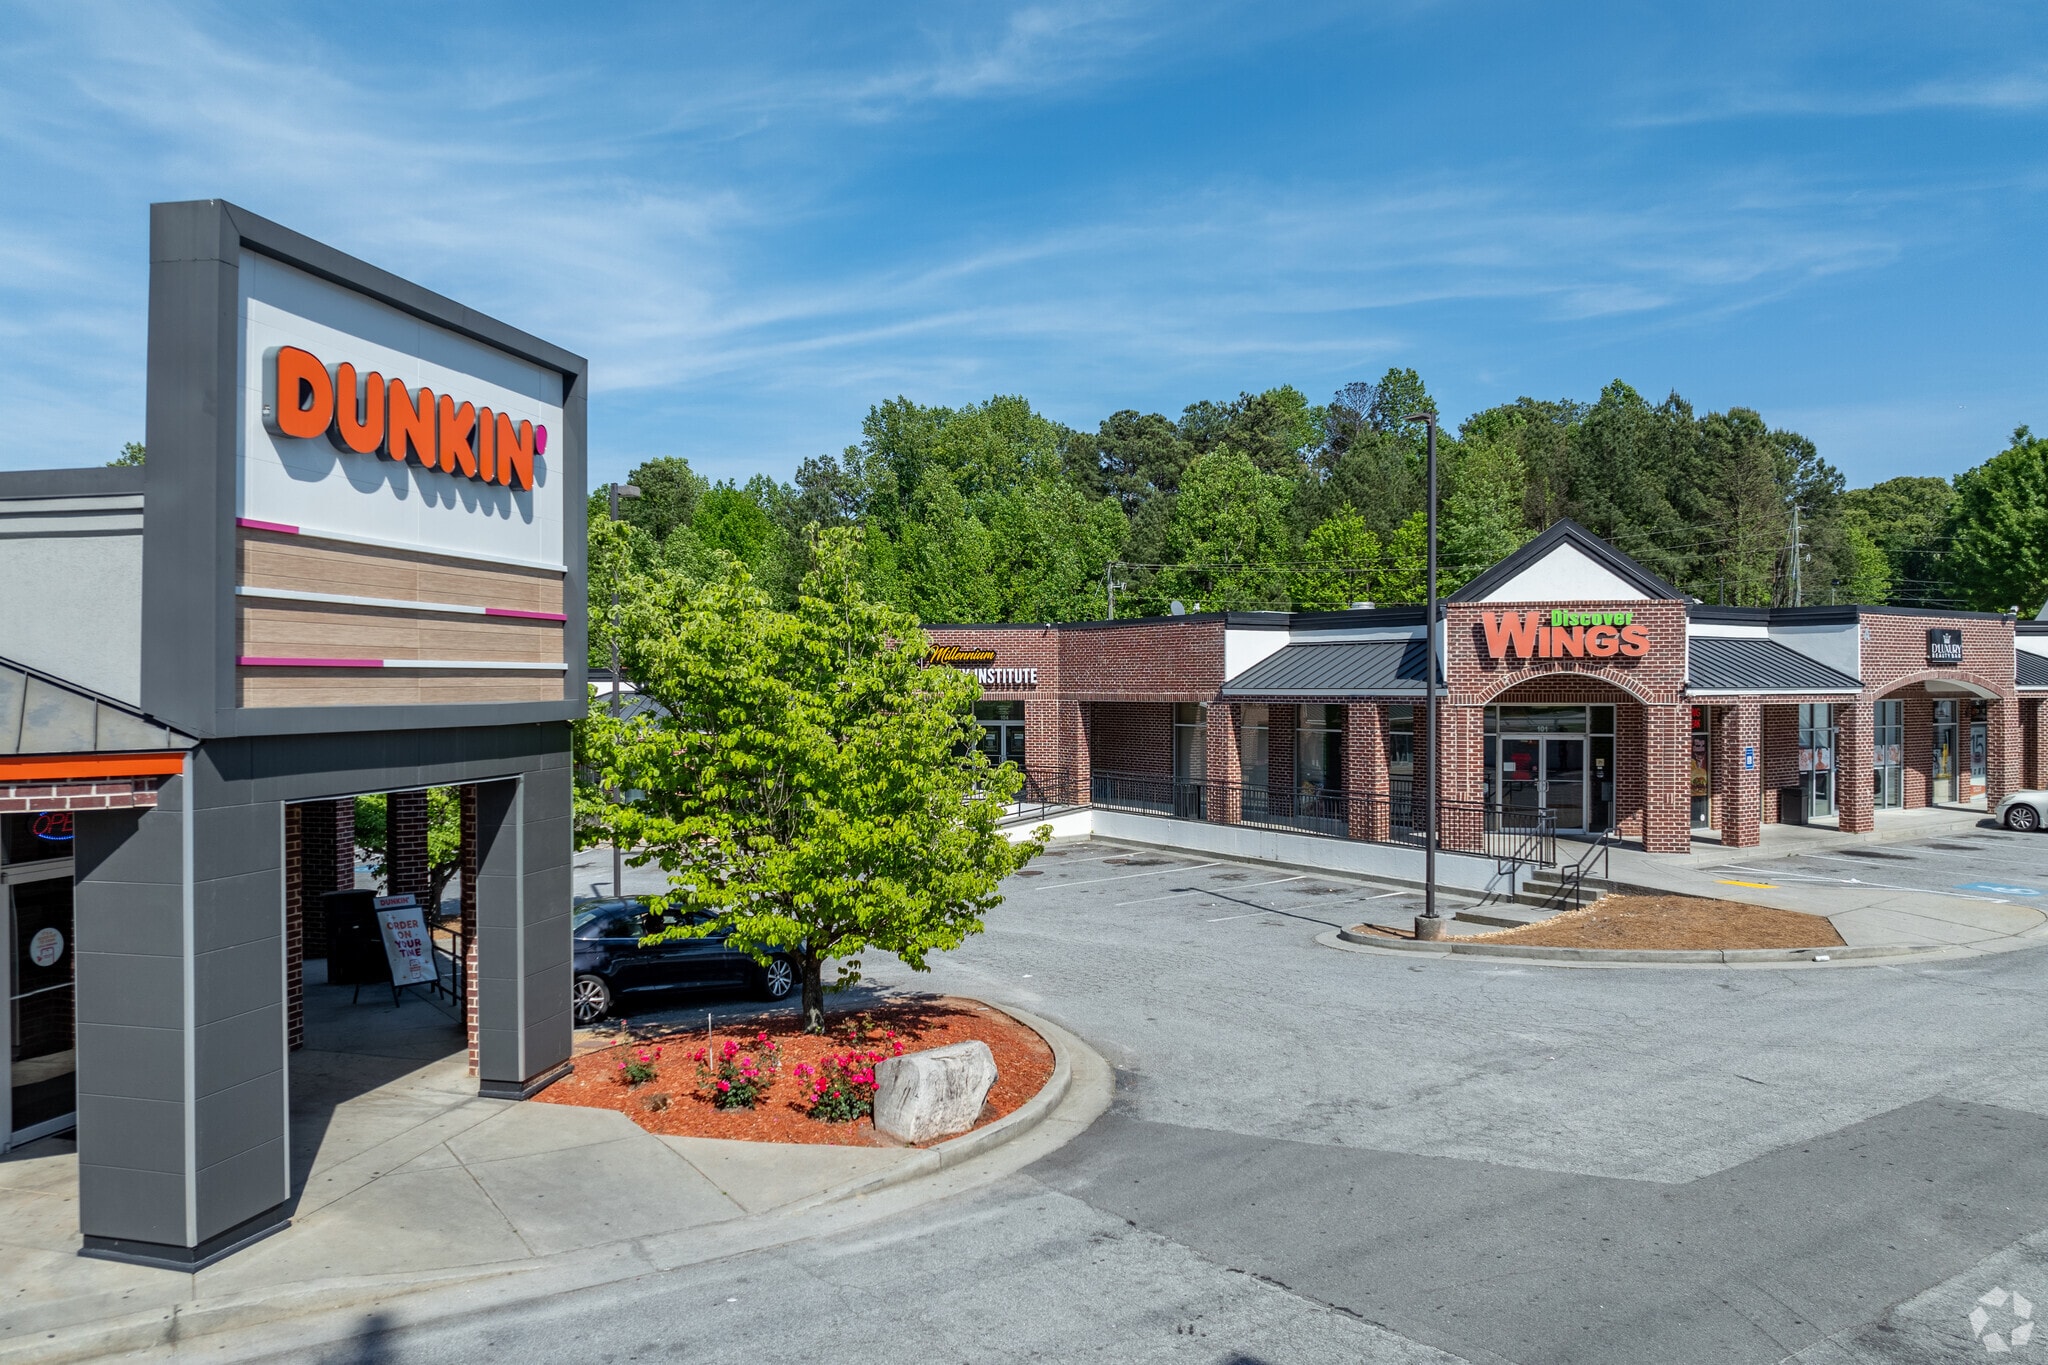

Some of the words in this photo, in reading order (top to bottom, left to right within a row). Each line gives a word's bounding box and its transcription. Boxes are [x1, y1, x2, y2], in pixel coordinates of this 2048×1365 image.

[270, 345, 547, 491] DUNKIN'
[1551, 609, 1633, 627] Discover
[1481, 611, 1651, 658] WINGS
[927, 643, 996, 665] Millennium
[975, 668, 1038, 684] INSTITUTE
[33, 811, 73, 835] OPE
[386, 920, 419, 930] ORDER
[394, 938, 422, 948] YOUR
[397, 930, 412, 939] ON
[399, 948, 422, 958] TIME
